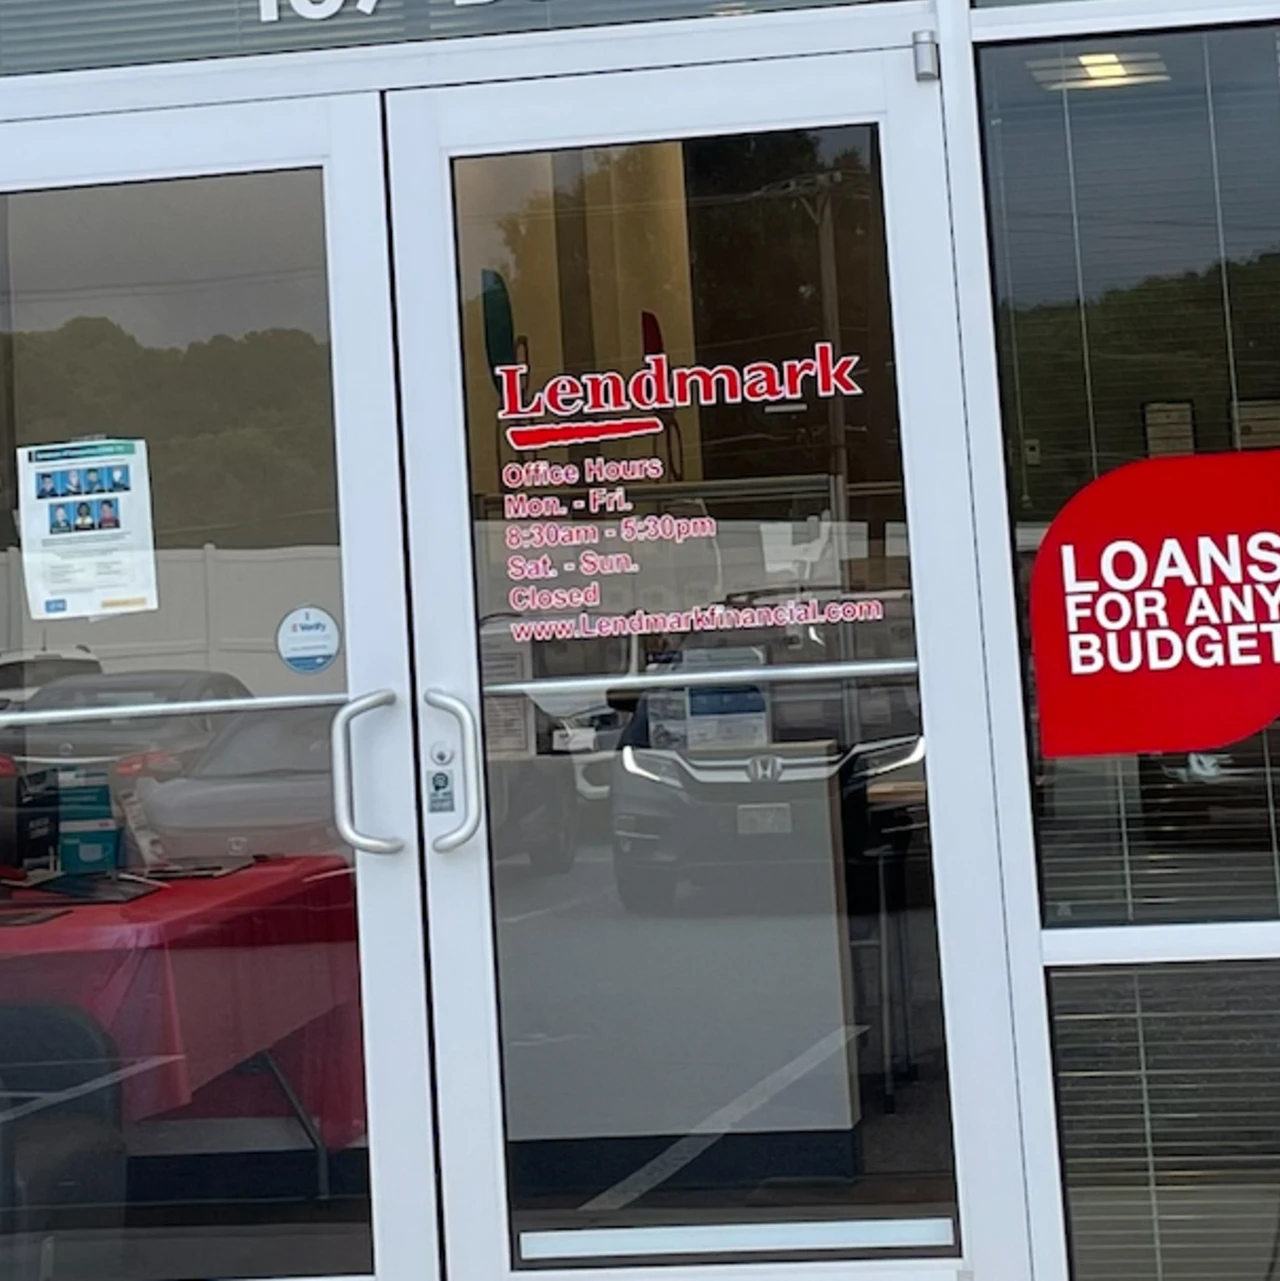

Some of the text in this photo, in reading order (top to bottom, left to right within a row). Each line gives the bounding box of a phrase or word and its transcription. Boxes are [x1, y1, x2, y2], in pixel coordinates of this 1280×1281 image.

[496, 342, 863, 419] Lendmark
[502, 457, 663, 488] Office Hours
[503, 493, 567, 518] Mon.
[588, 487, 633, 513] Fri.
[506, 524, 599, 549] 8:30am
[621, 515, 717, 544] 5:30pm
[508, 553, 558, 580] Sat.
[580, 550, 639, 575] Sun.
[509, 582, 600, 611] Closed
[1065, 590, 1169, 632] FOR
